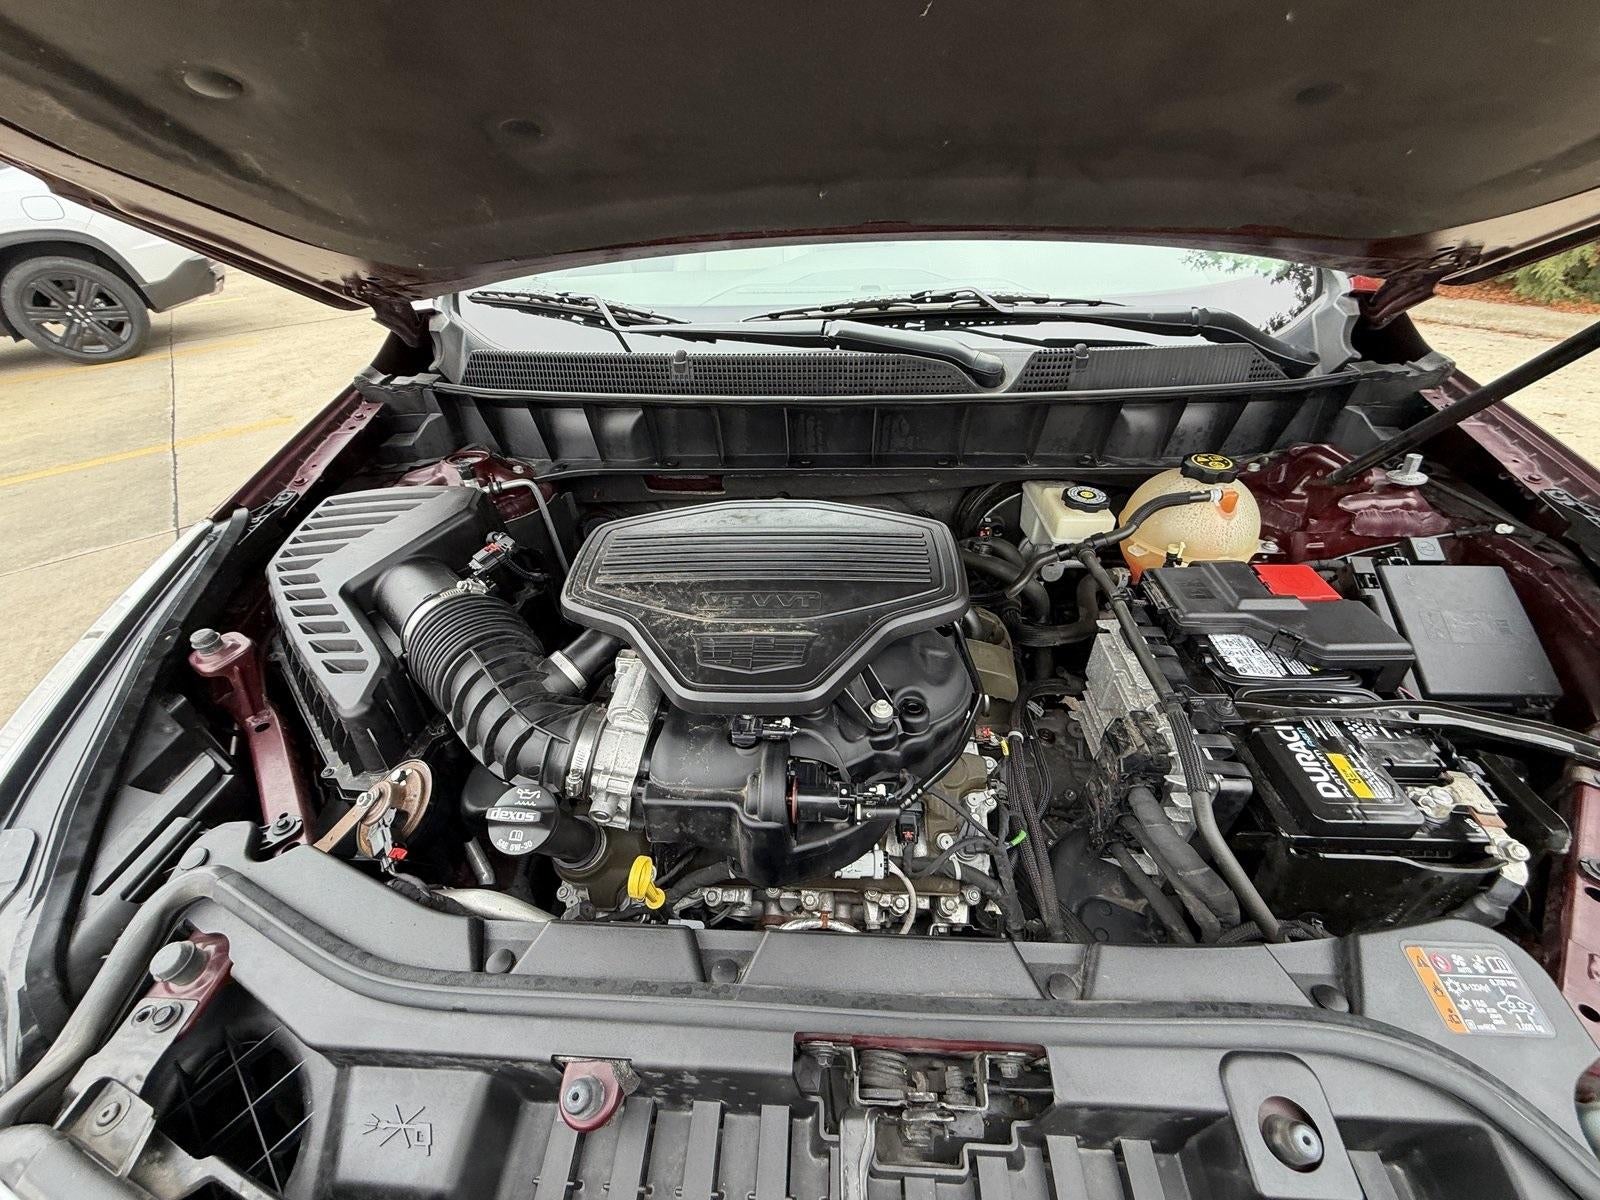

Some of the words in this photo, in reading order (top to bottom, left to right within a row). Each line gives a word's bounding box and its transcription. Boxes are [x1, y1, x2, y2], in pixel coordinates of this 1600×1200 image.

[1273, 725, 1344, 797] DURAC
[1313, 749, 1353, 797] PLATINUM
[491, 808, 537, 822] dexos
